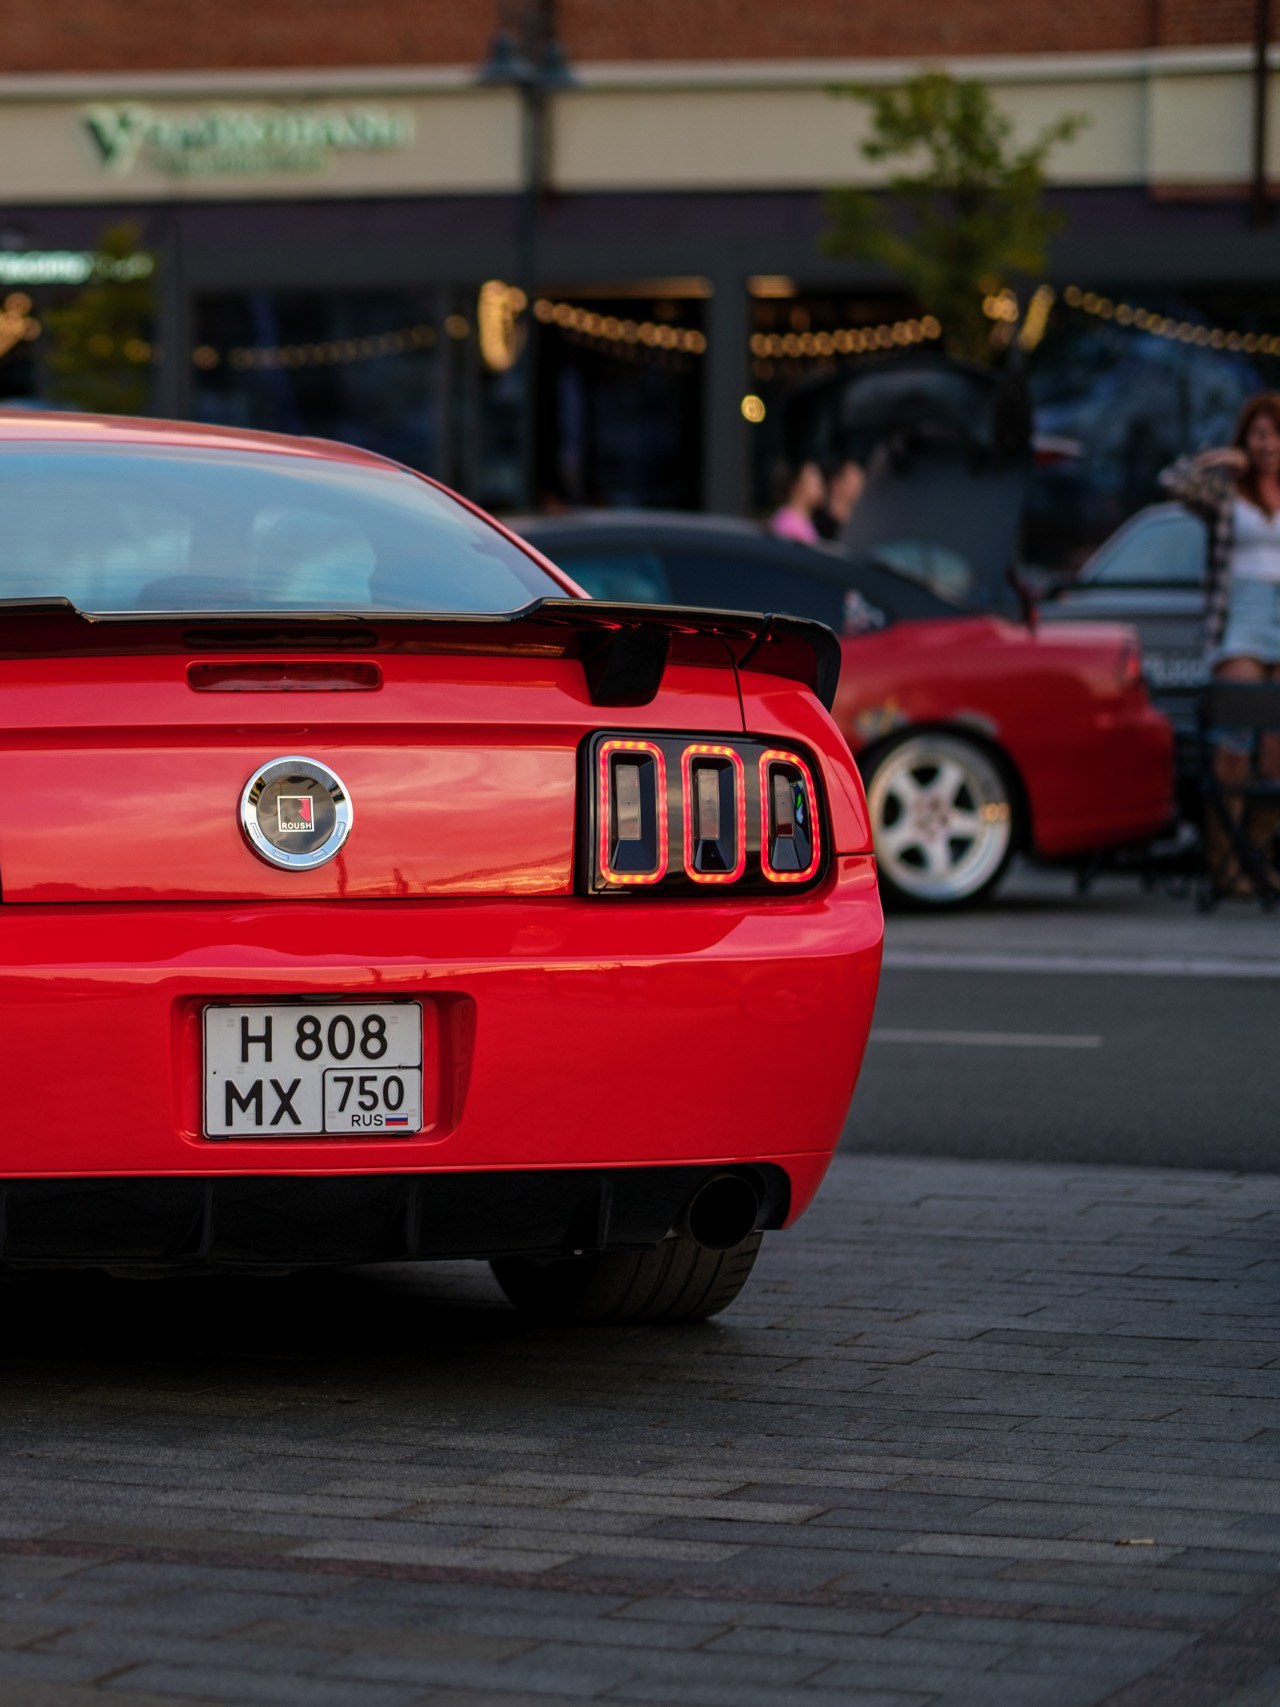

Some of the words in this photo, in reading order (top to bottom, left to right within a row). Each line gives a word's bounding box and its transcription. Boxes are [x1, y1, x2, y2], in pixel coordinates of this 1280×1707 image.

[281, 822, 312, 830] ROUSH
[241, 1015, 272, 1062] H
[295, 1014, 387, 1061] 808
[225, 1078, 302, 1126] MX
[333, 1075, 404, 1112] 750
[351, 1114, 383, 1127] RUS
